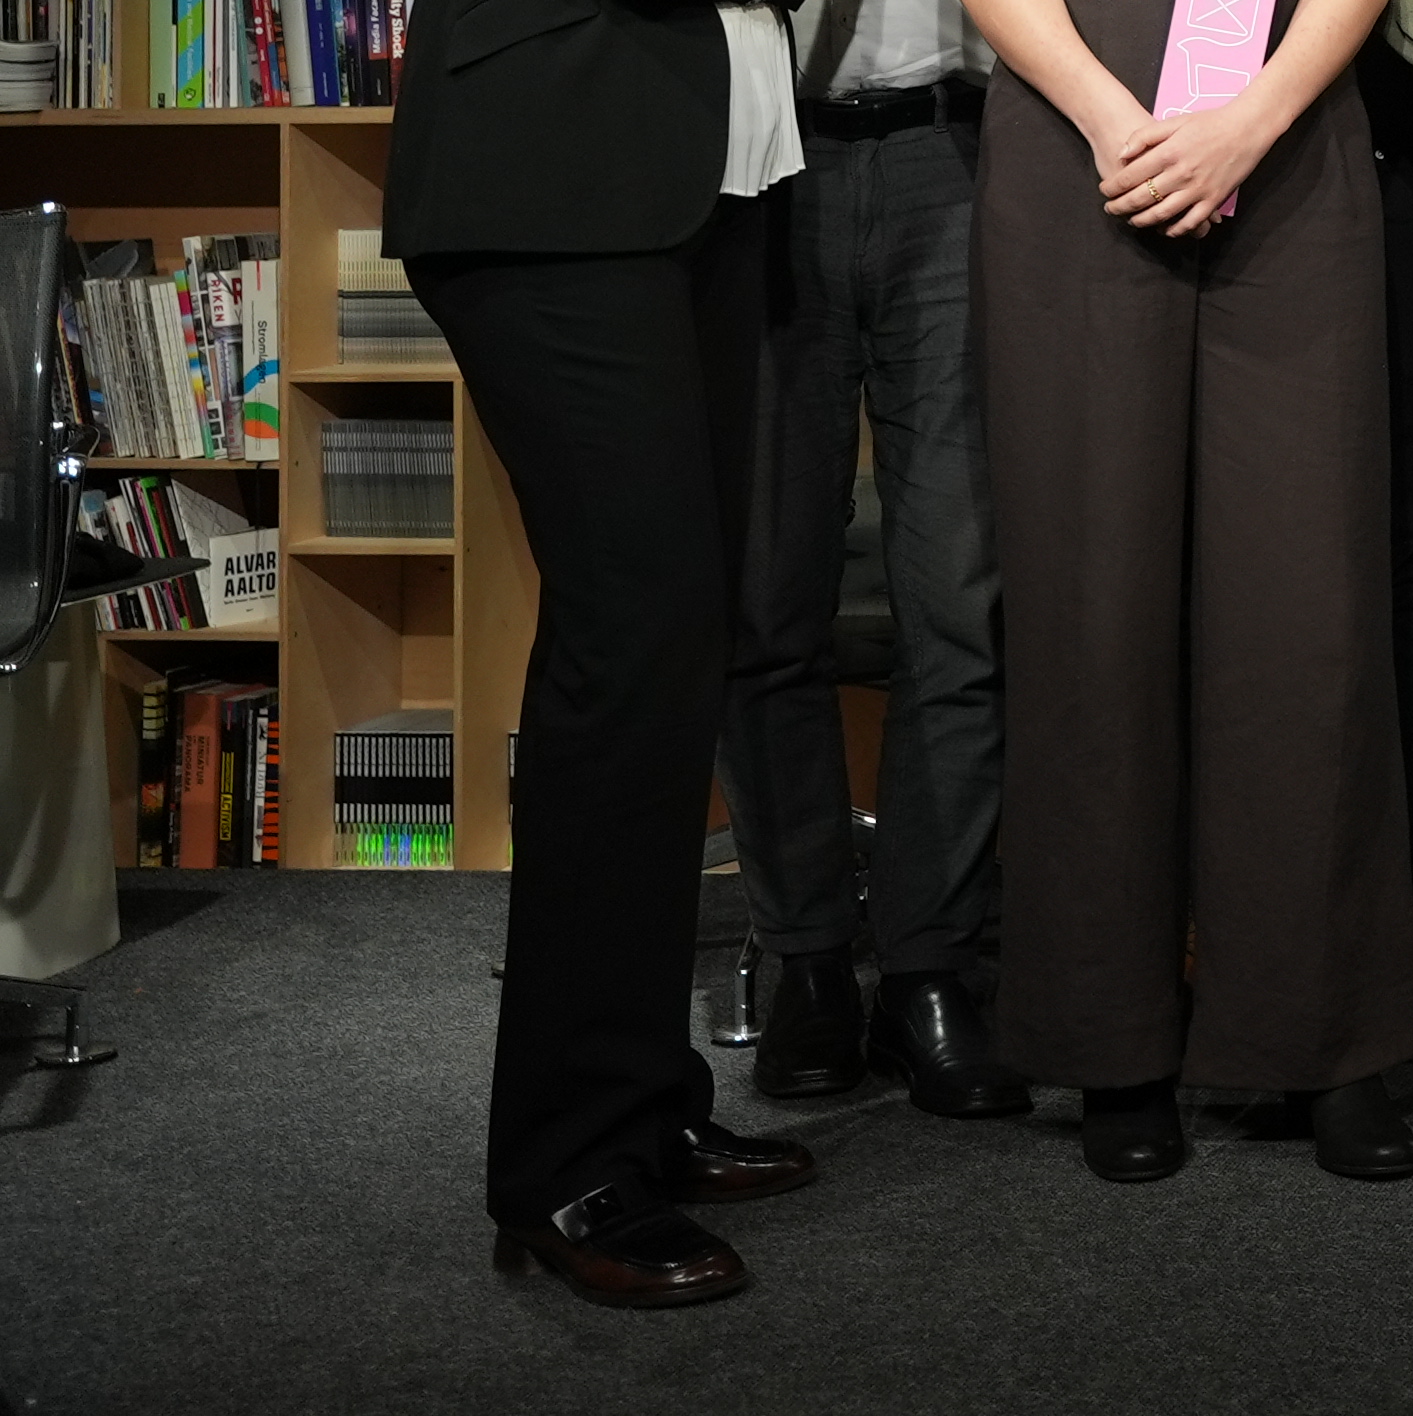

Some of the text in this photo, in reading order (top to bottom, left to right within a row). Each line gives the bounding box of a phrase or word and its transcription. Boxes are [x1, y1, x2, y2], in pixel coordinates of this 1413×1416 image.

[369, 23, 381, 54] Media
[390, 18, 404, 59] Shock
[210, 279, 225, 322] RIKEN
[257, 320, 268, 384] Stromlagen
[224, 551, 276, 576] ALVAR
[224, 572, 276, 598] AALTO
[184, 735, 192, 792] PANORAMA
[196, 736, 204, 785] MINIATUR
[221, 796, 231, 839] ACTIVISM
